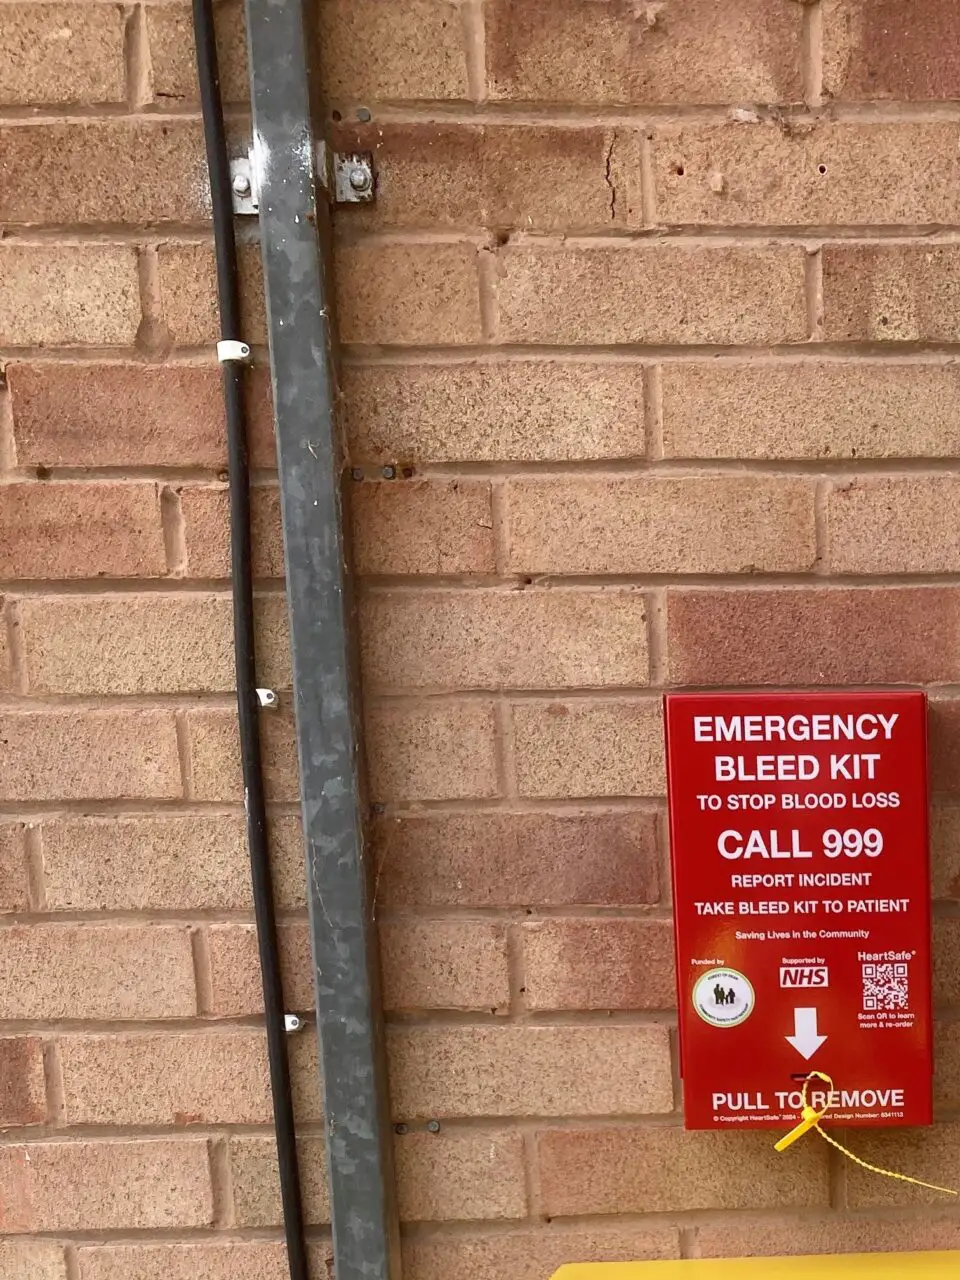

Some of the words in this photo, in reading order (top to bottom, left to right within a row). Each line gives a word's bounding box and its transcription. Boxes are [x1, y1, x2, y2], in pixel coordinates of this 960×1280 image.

[694, 714, 898, 742] EMERGENCY
[715, 755, 819, 781] BLEED
[830, 754, 880, 780] KIT
[697, 795, 722, 810] TO
[727, 794, 775, 810] STOP
[782, 793, 846, 809] BLOOD
[852, 792, 900, 808] LOSS
[717, 829, 812, 859] CALL
[822, 828, 883, 858] 999
[731, 874, 794, 888] REPORT
[799, 873, 872, 886] INCIDENT
[694, 902, 734, 915] TAKE
[739, 901, 789, 914] BLEED
[794, 901, 818, 914] KIT
[822, 900, 843, 914] TO
[848, 899, 909, 912] PATIENT
[736, 931, 765, 941] Saving
[767, 930, 790, 939] Lives
[793, 930, 801, 939] in
[803, 930, 817, 939] the
[819, 929, 869, 940] Community
[717, 958, 725, 966] by
[782, 957, 816, 965] Supported
[816, 957, 825, 965] by
[782, 968, 825, 986] NHS
[876, 1012, 888, 1020] QR
[712, 1092, 769, 1110] PULL
[775, 1091, 803, 1109] TO
[812, 1089, 904, 1108] REMOVE
